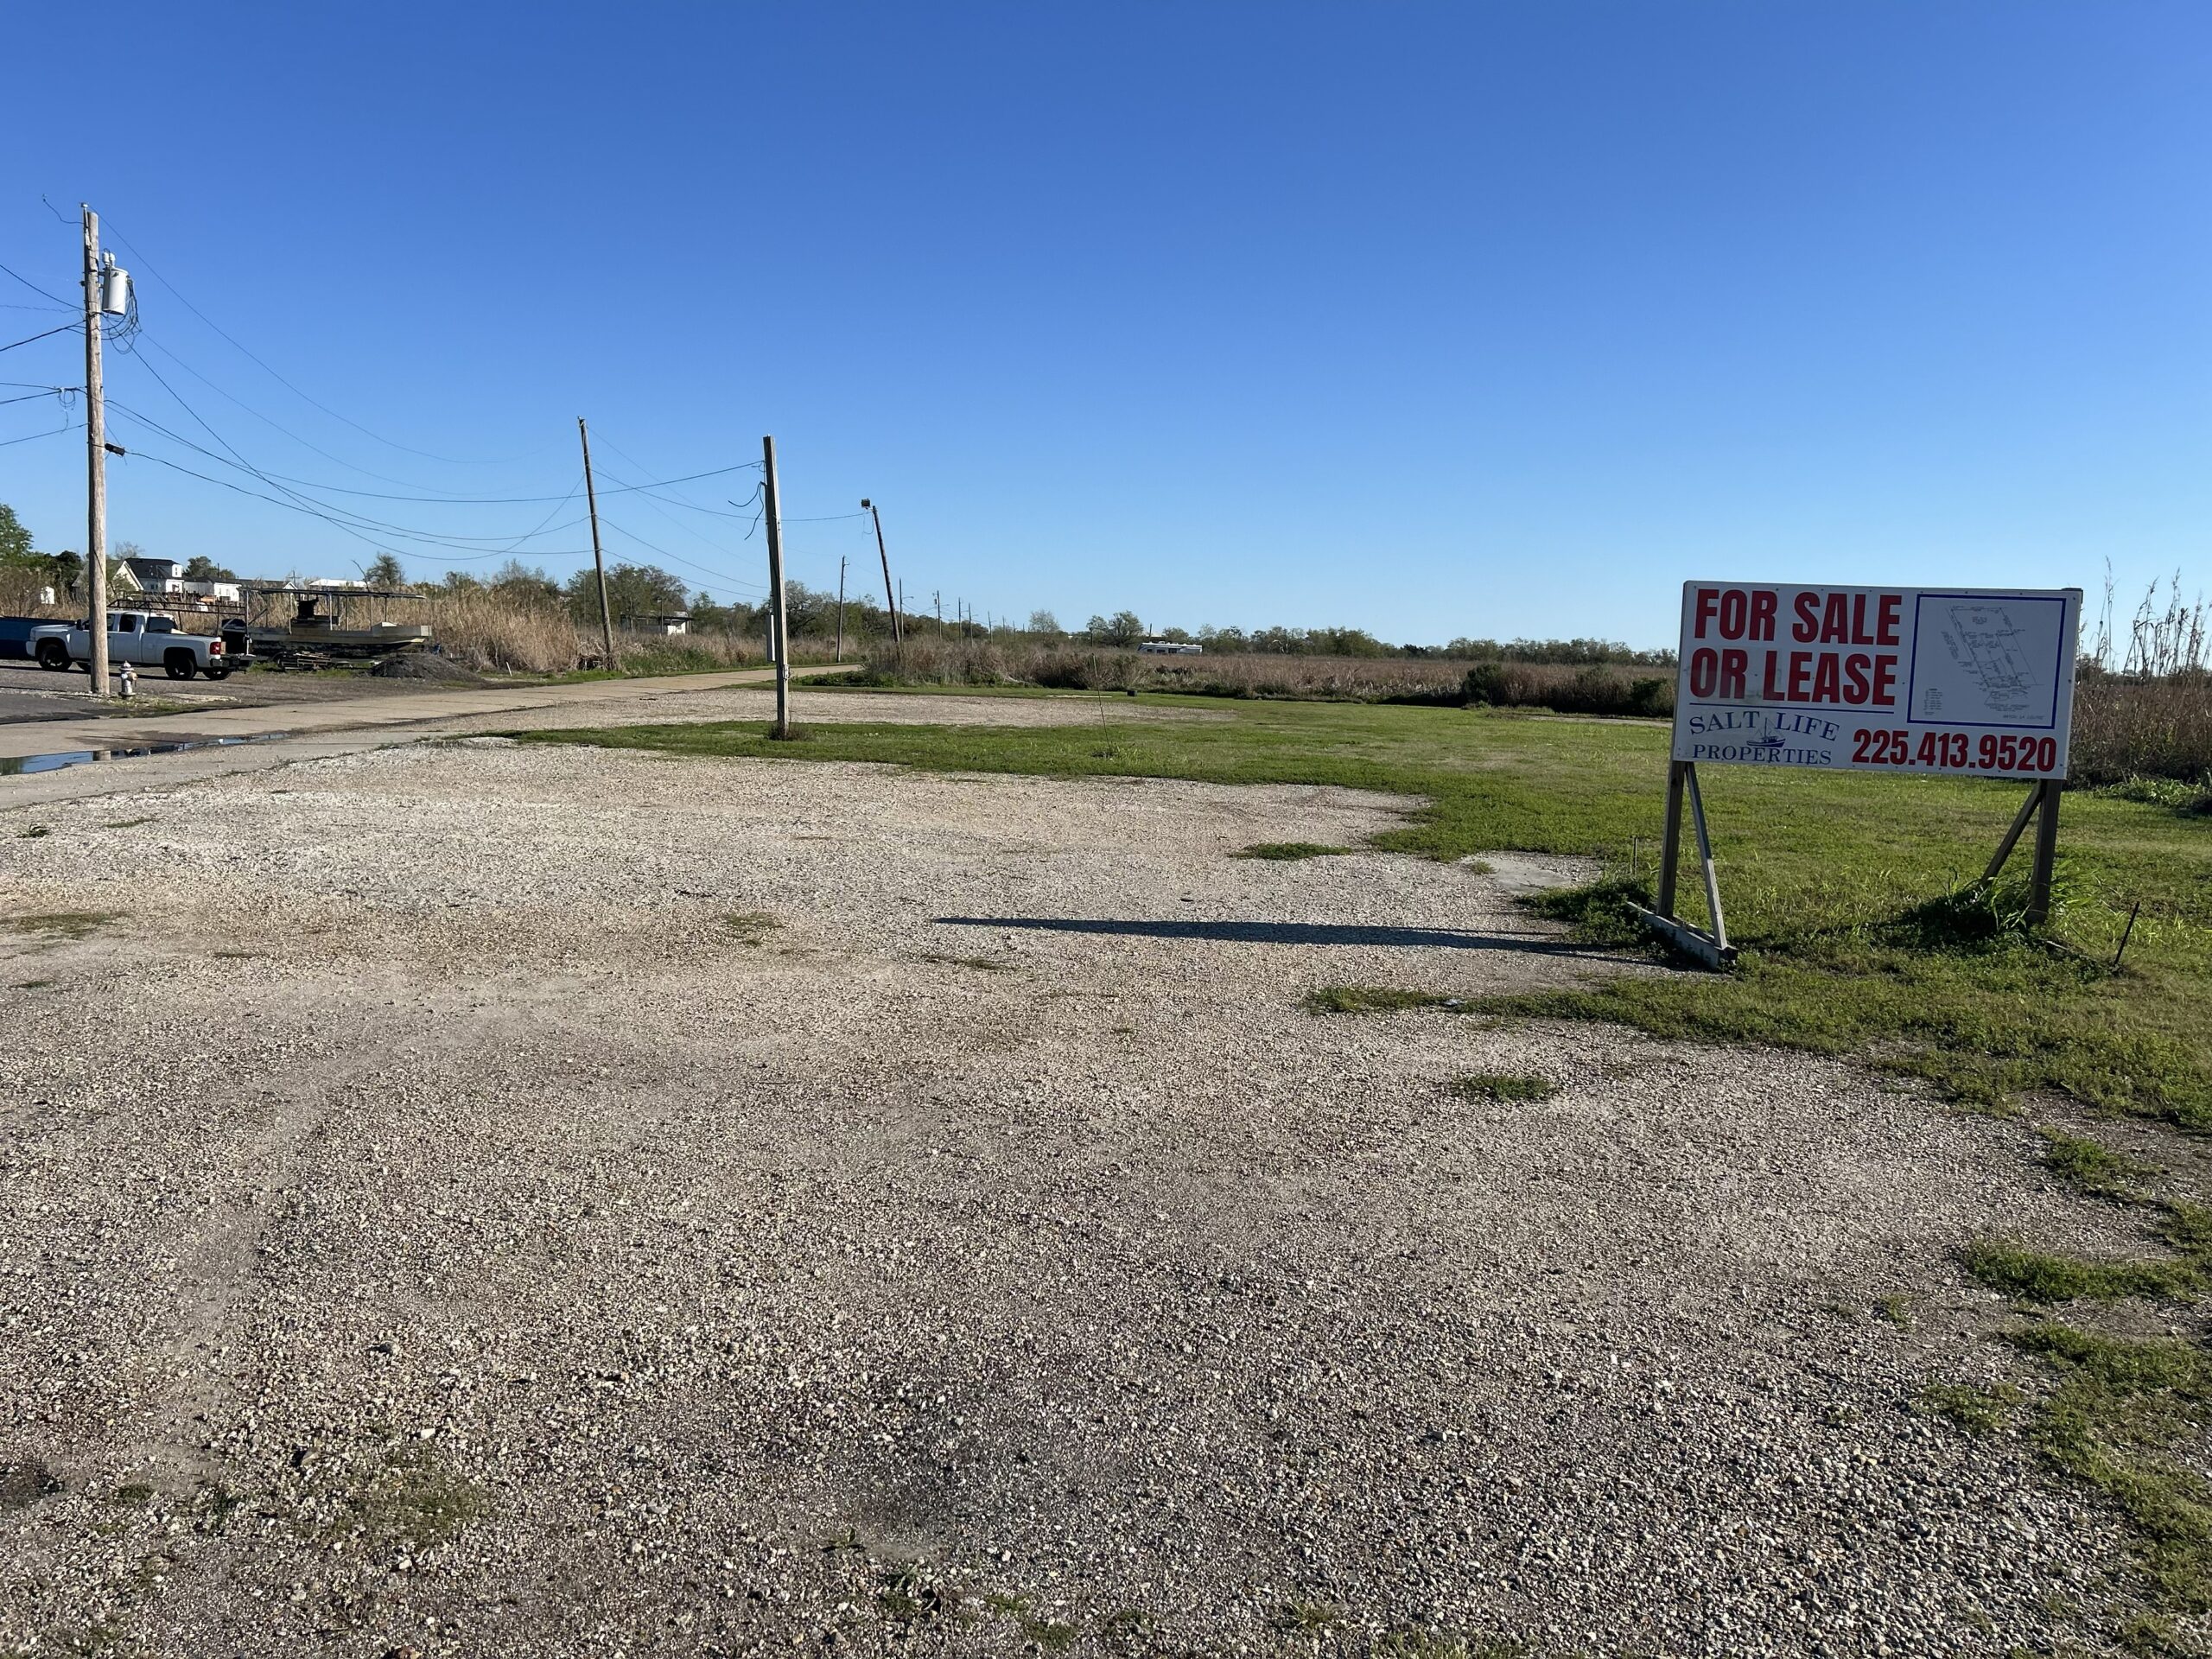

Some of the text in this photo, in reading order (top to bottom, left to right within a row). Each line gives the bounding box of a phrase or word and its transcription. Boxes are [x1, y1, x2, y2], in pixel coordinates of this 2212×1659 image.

[1694, 589, 1777, 641] FOR
[1792, 592, 1902, 645] SALE
[1690, 647, 1748, 699] OR
[1763, 650, 1897, 706] LEASE
[1689, 711, 1840, 741] SALT LIFE
[1693, 744, 1831, 765] PROPERTIES
[1852, 728, 2056, 772] 225.413.9520
